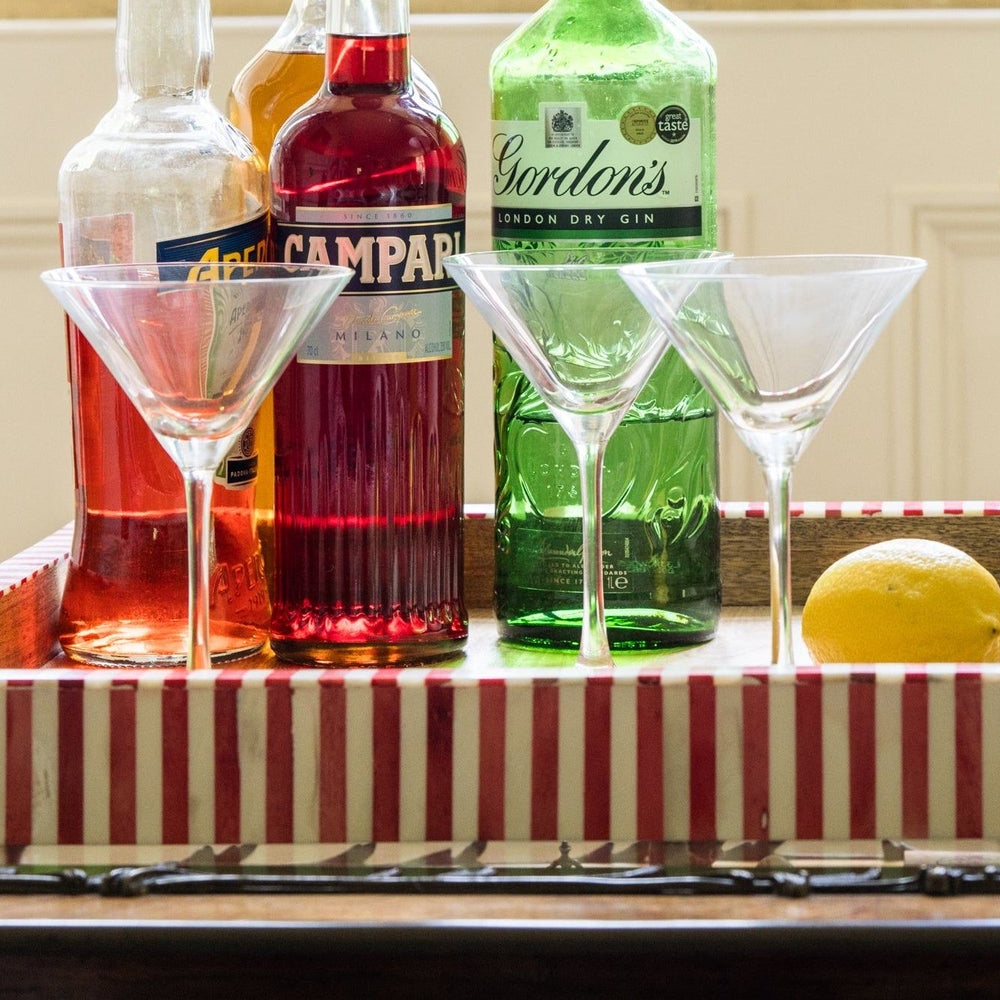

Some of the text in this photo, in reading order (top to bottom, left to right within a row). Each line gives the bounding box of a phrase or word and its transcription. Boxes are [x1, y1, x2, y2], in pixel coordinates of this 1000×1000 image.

[665, 113, 682, 121] great
[658, 120, 689, 132] taste
[493, 132, 668, 197] Gordon's
[343, 212, 379, 220] SINCE
[498, 213, 655, 225] LONDON DRY GIN
[335, 328, 421, 341] MILANO
